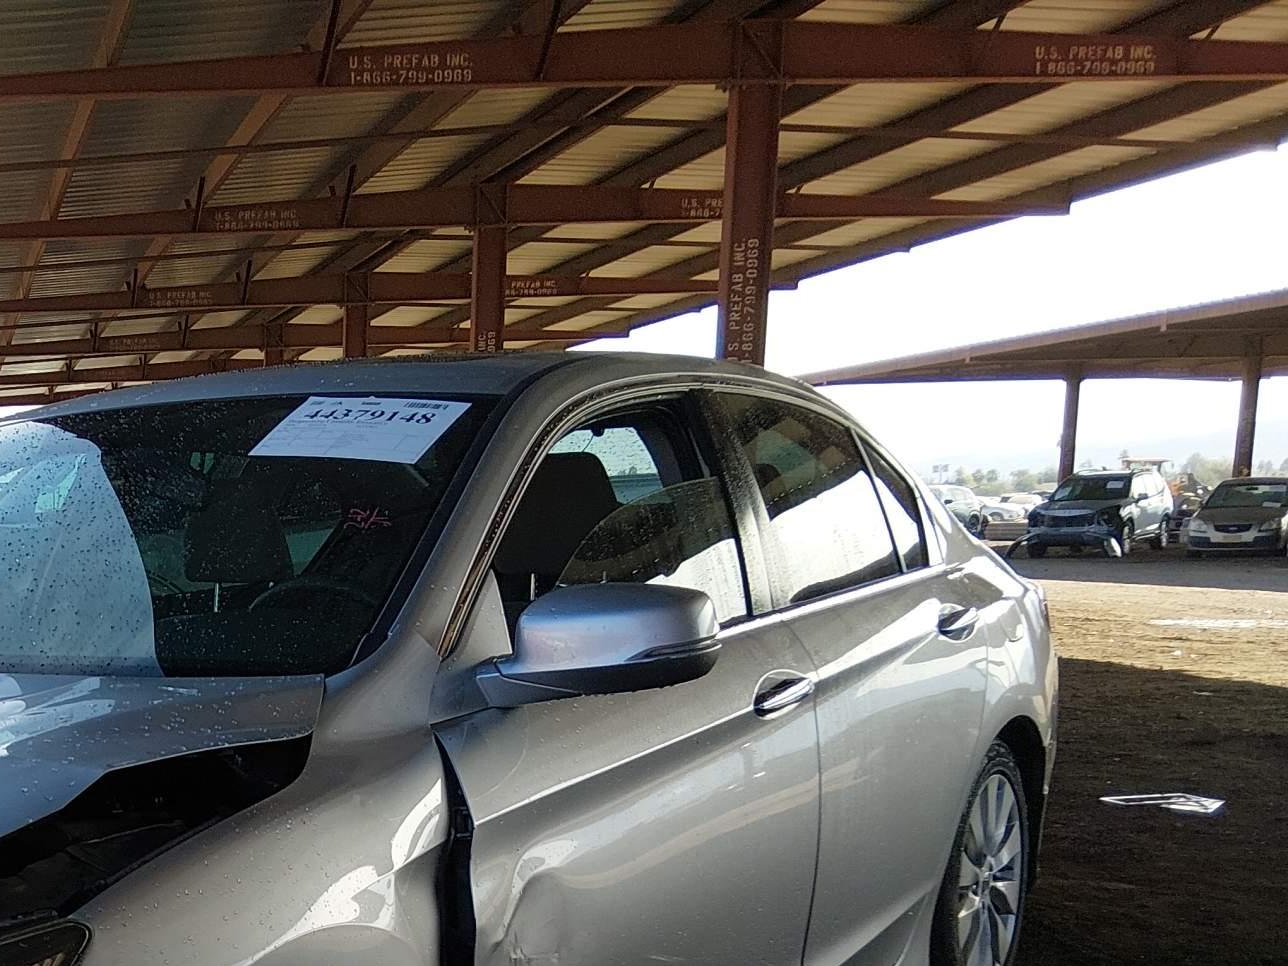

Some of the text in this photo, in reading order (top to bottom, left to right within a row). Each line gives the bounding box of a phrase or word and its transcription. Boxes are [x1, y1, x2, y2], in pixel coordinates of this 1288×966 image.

[349, 51, 473, 70] U.S. PREFAB INC.
[1034, 45, 1157, 60] U.S. PREFAB INC.
[350, 69, 472, 85] 1-866-799-0969
[1034, 62, 1155, 75] 1866-799-0969
[732, 238, 746, 266] INC.
[728, 273, 744, 331] PREFAB
[303, 408, 437, 425] 44379148
